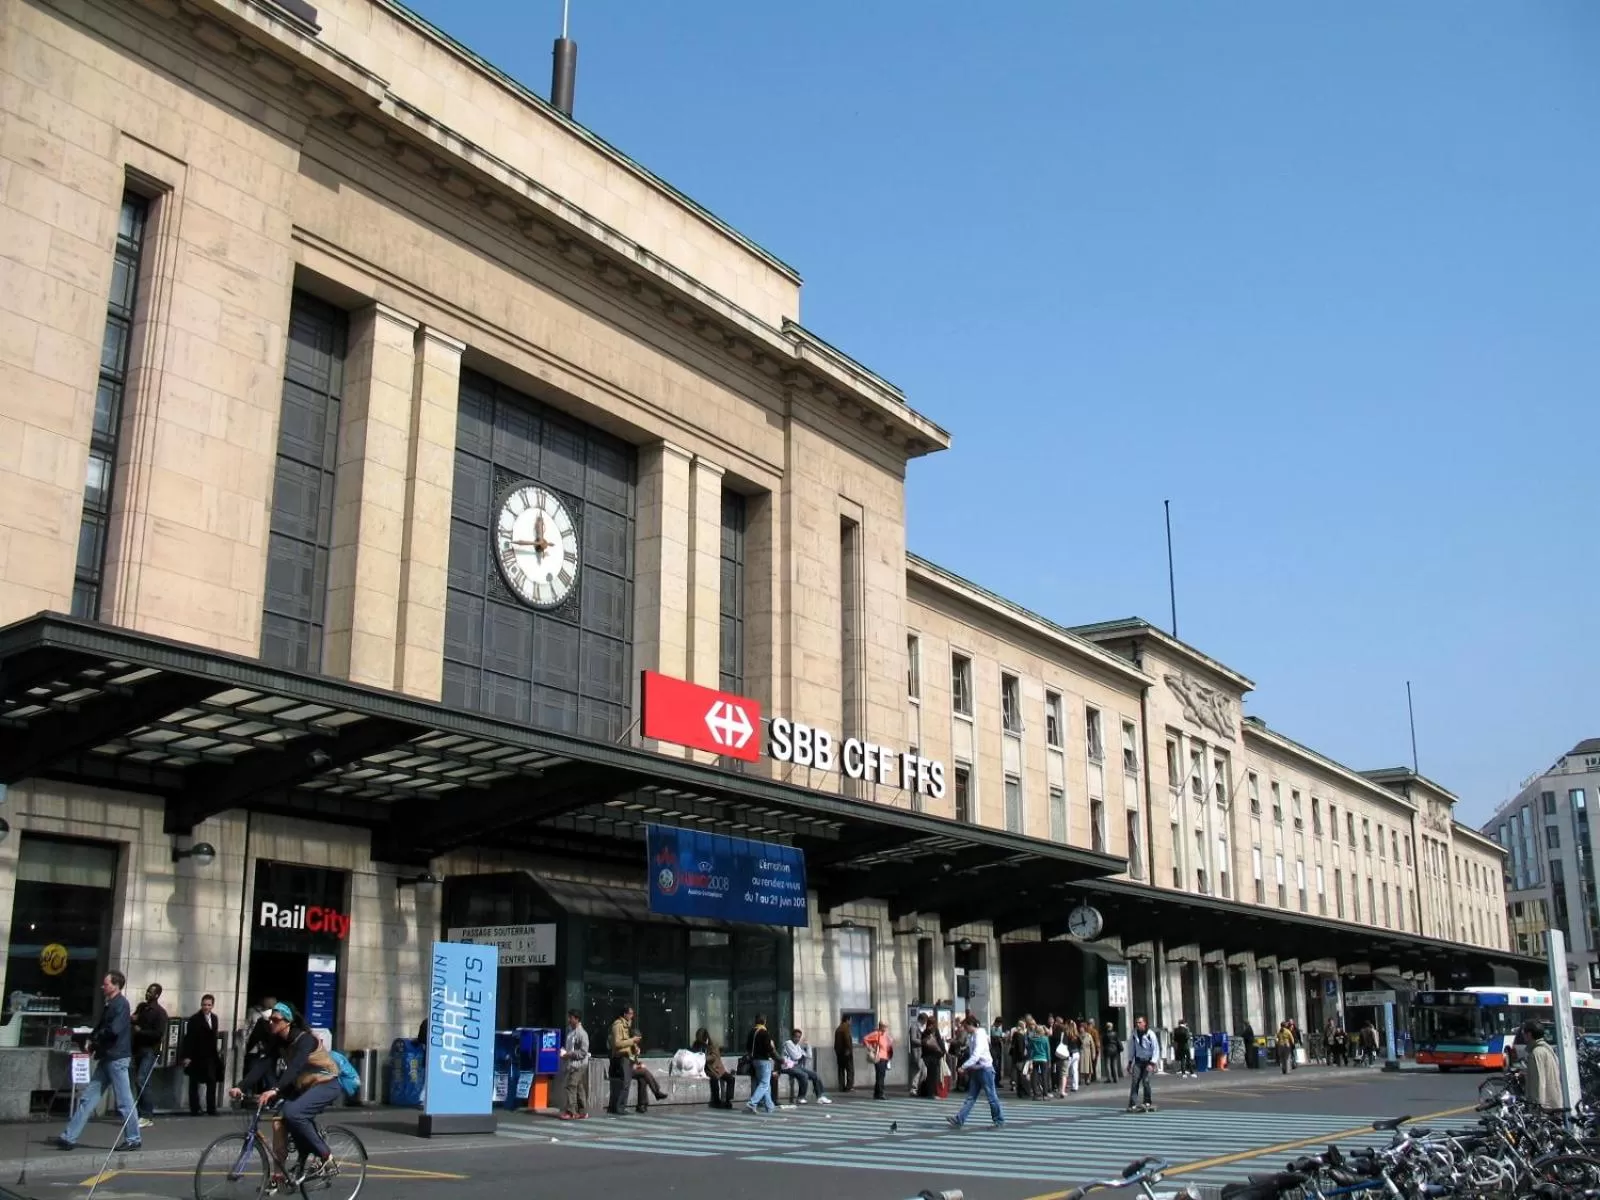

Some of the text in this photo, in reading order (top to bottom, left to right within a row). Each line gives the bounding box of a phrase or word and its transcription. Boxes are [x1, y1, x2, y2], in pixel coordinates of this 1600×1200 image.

[768, 717, 946, 798] SBB CFF FFS
[744, 891, 754, 902] du
[760, 895, 769, 905] au
[260, 901, 351, 939] RailCity
[462, 926, 536, 937] PASSAGE SOUTERRAIN
[500, 954, 547, 964] CENTRE VILLE
[440, 985, 469, 1076] GARE
[460, 956, 483, 1087] GUICHETS
